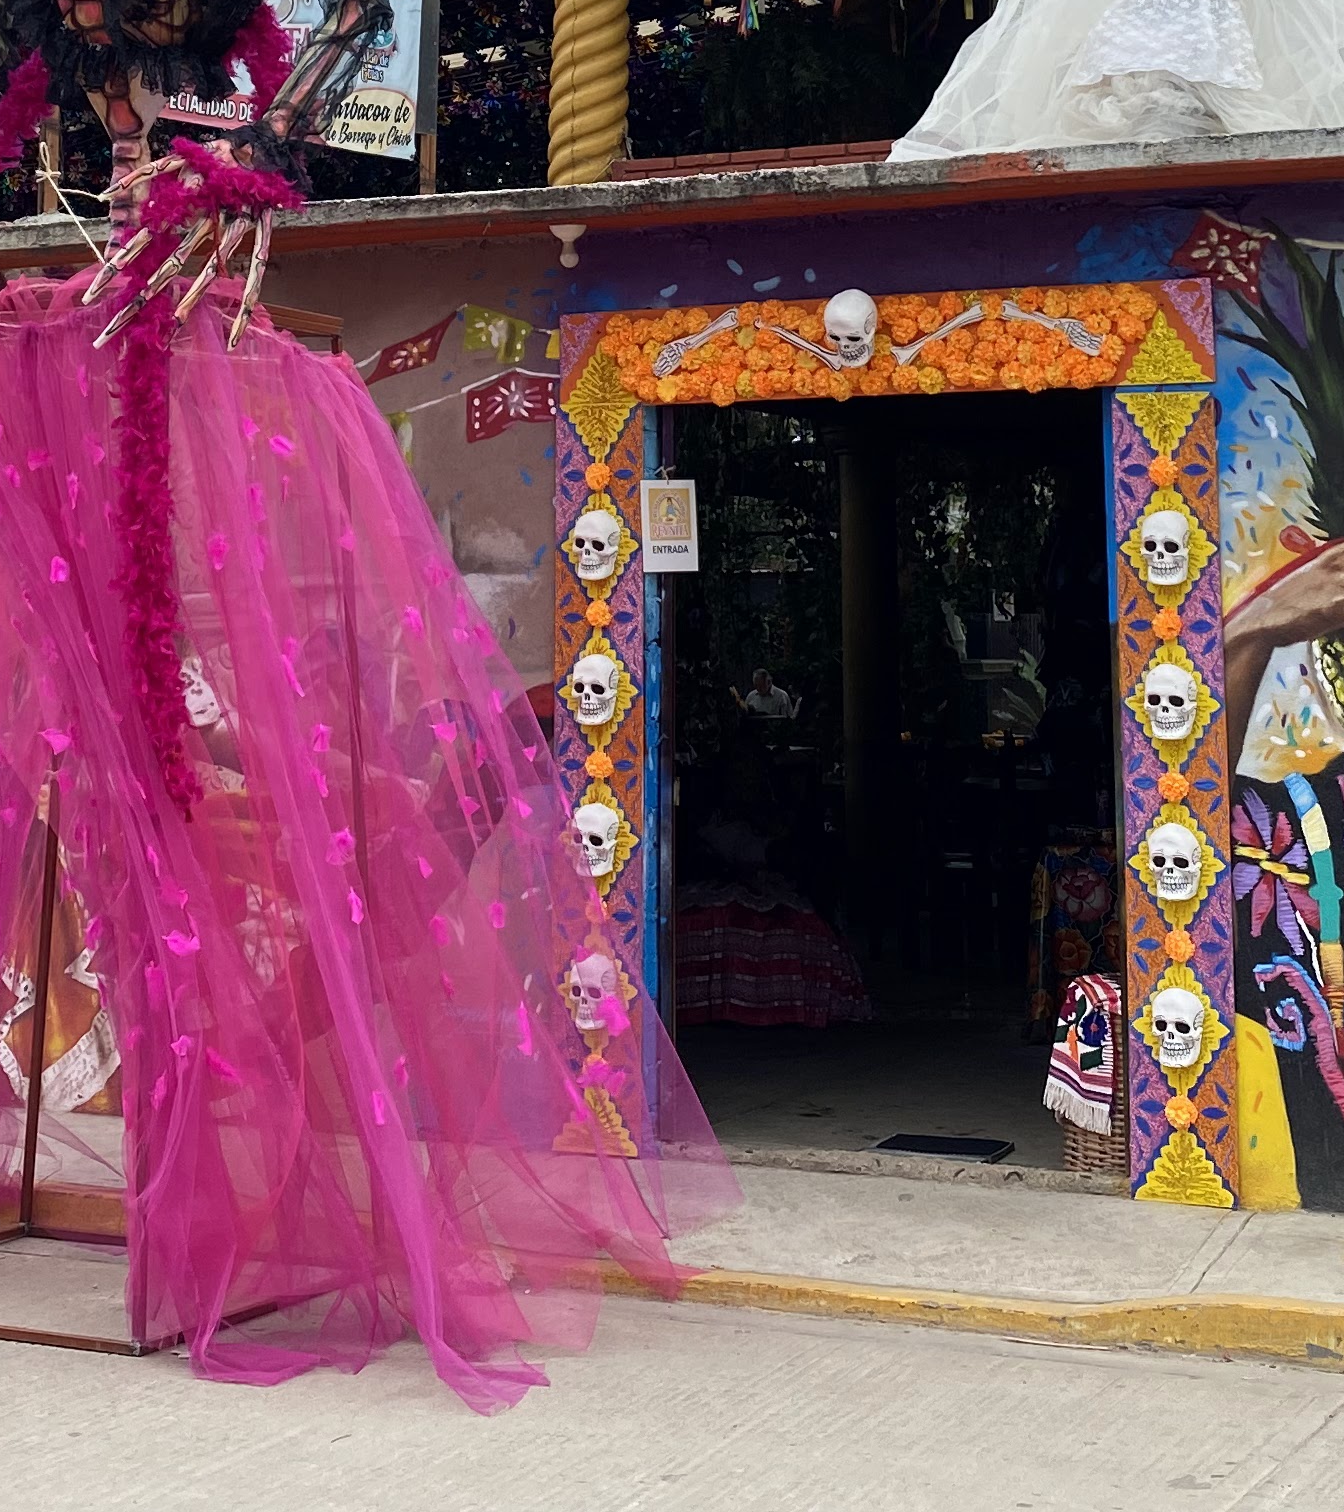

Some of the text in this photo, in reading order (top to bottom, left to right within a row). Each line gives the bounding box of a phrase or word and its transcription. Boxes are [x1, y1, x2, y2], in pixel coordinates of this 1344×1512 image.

[169, 91, 237, 119] ECIALIDAD
[333, 95, 411, 124] arbacoa de
[338, 121, 376, 150] Borrego
[377, 132, 385, 150] y
[386, 126, 413, 147] Chivo
[652, 545, 689, 555] ENTRADA
